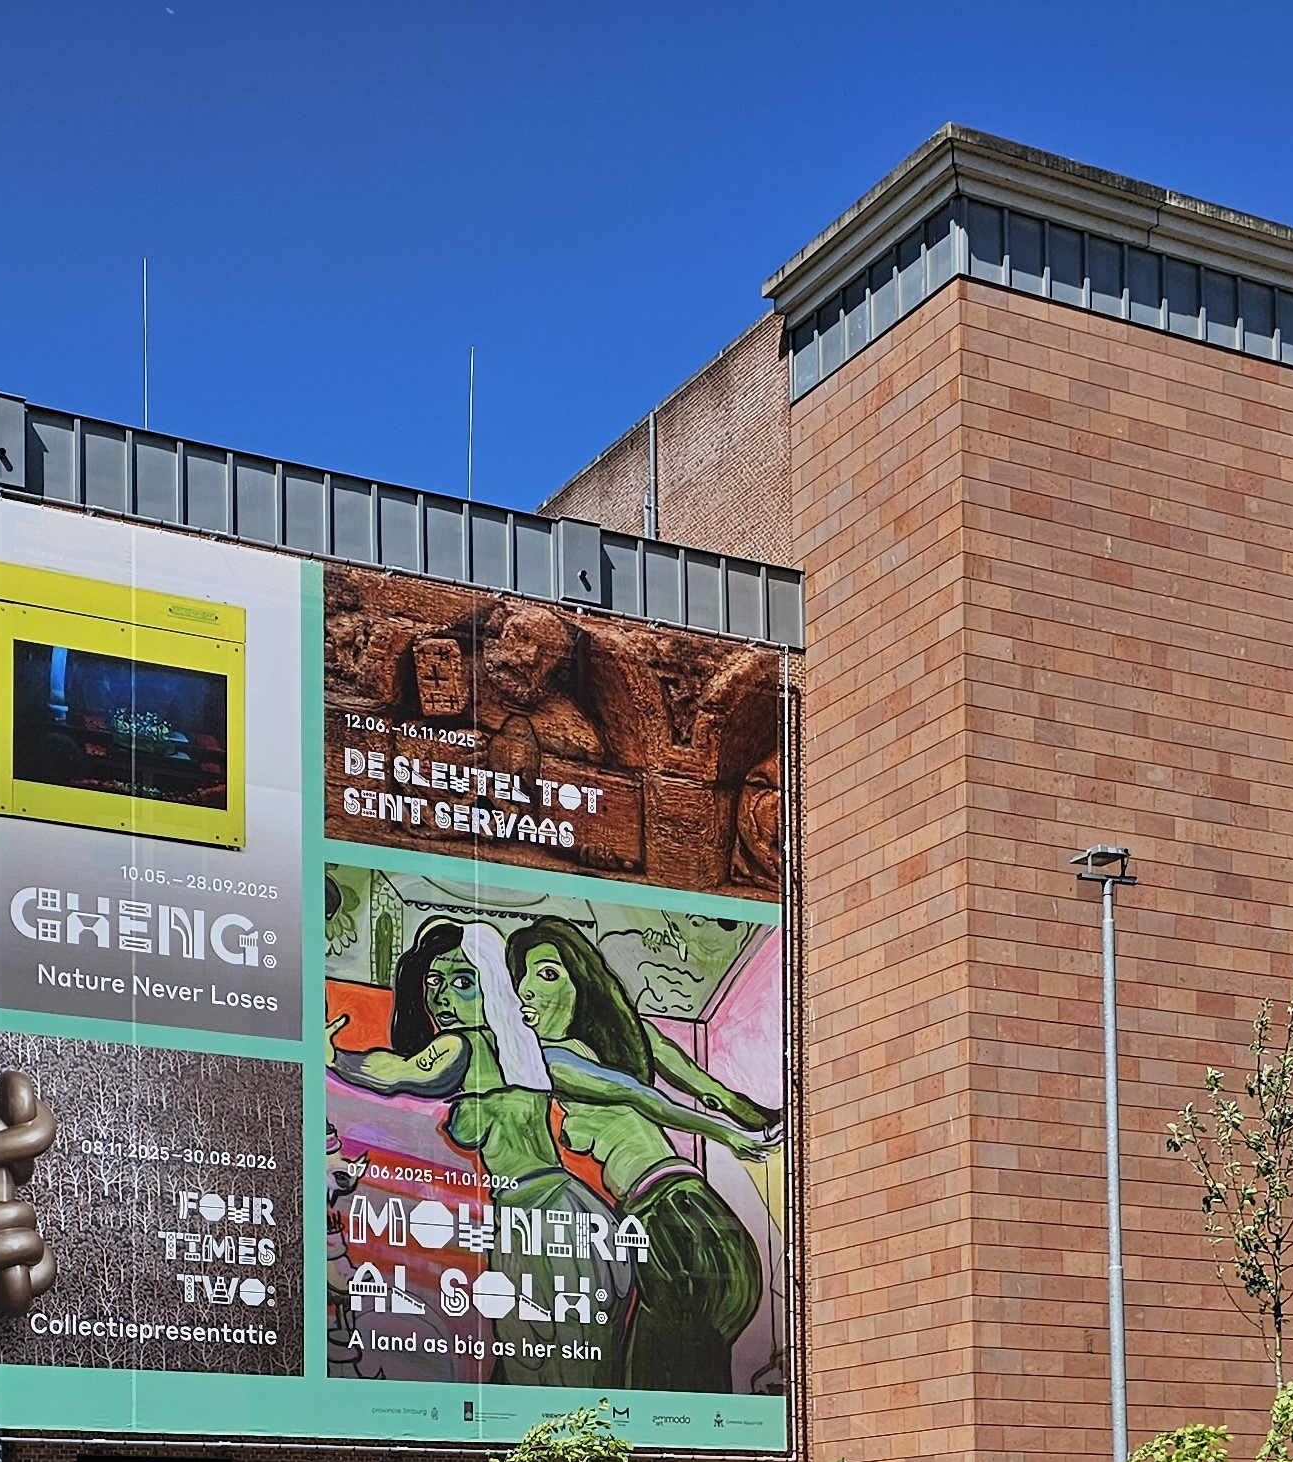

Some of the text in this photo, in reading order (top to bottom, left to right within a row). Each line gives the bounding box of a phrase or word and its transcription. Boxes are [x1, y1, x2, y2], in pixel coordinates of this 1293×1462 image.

[344, 747, 604, 814] DE SLEUTEL TOT
[343, 787, 576, 848] SINT SERVAAS
[10, 886, 278, 969] CHENG:
[37, 963, 279, 1012] Nature Never Loses
[178, 1190, 277, 1226] FOUR
[348, 1195, 650, 1263] MOUNIRA
[157, 1231, 276, 1267] TIMES
[176, 1273, 277, 1307] TWO:
[348, 1261, 609, 1325] AL SOLH:
[30, 1312, 278, 1346] Collectiepresentatie
[347, 1330, 602, 1361] A land as big as her skin
